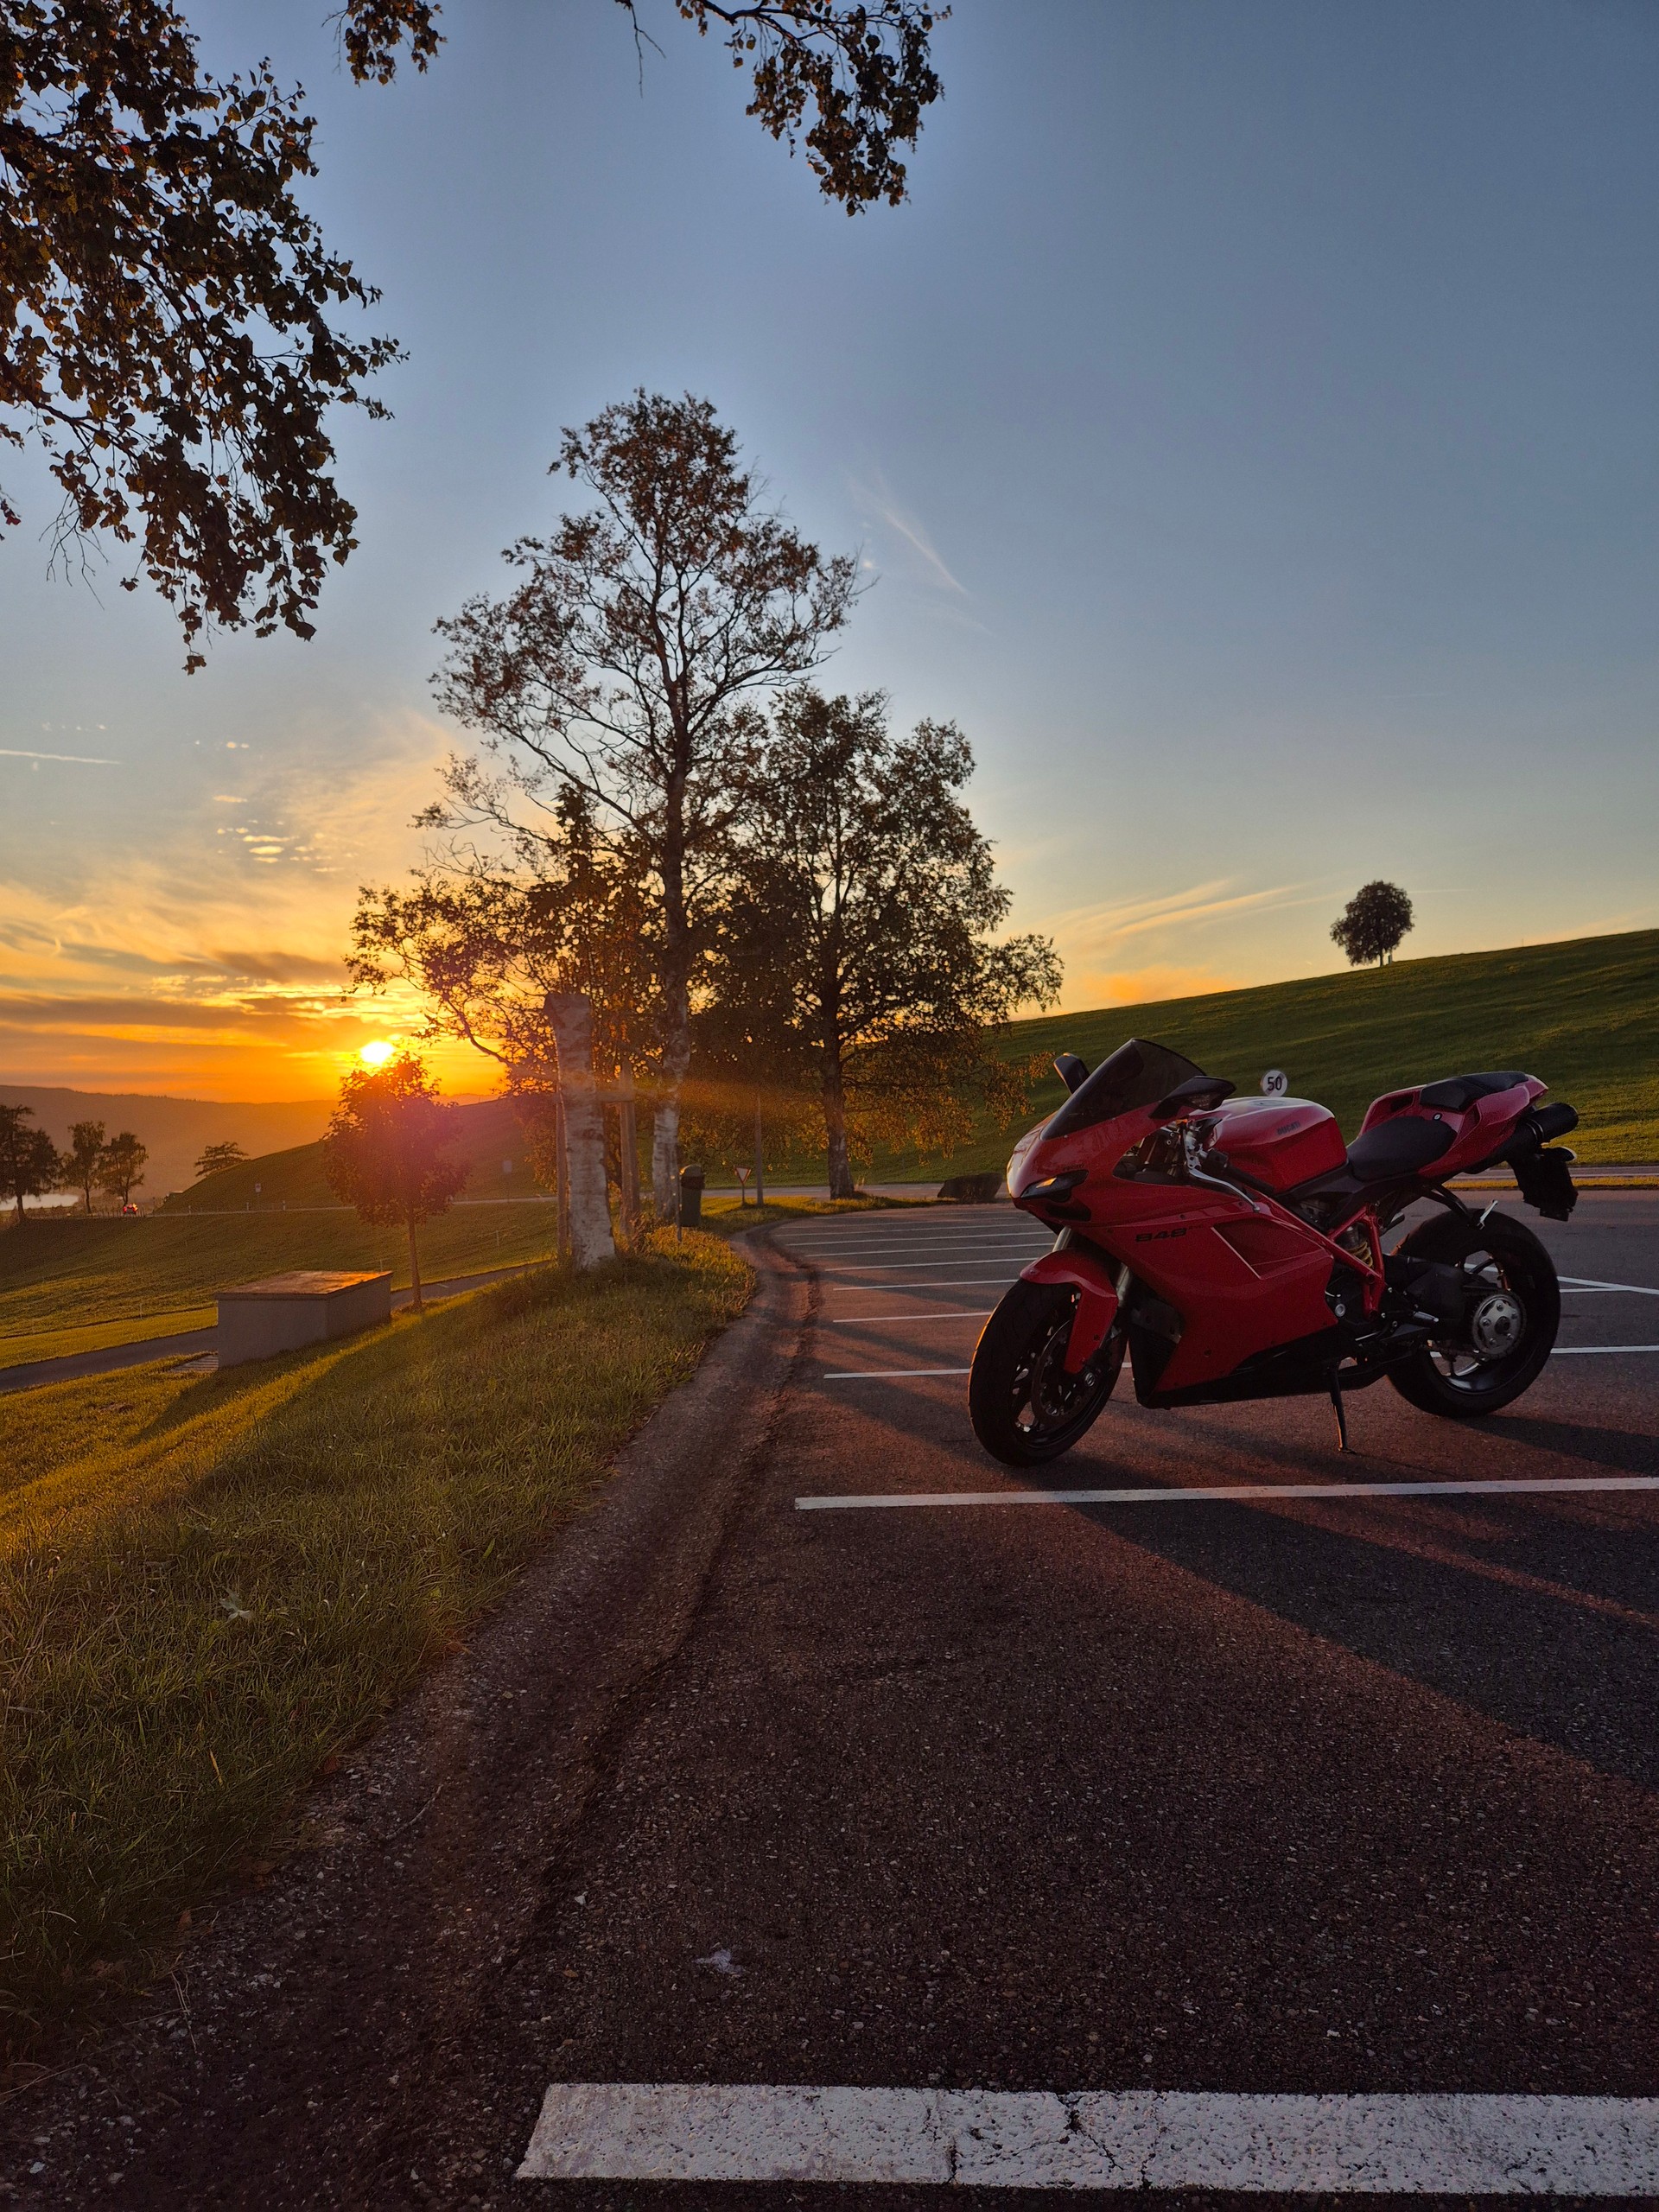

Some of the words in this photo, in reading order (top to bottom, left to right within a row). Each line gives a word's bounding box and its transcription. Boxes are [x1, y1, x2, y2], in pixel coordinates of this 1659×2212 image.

[1268, 1076, 1282, 1091] 50
[1277, 1121, 1300, 1135] DUCATI
[1135, 1227, 1187, 1243] 848
